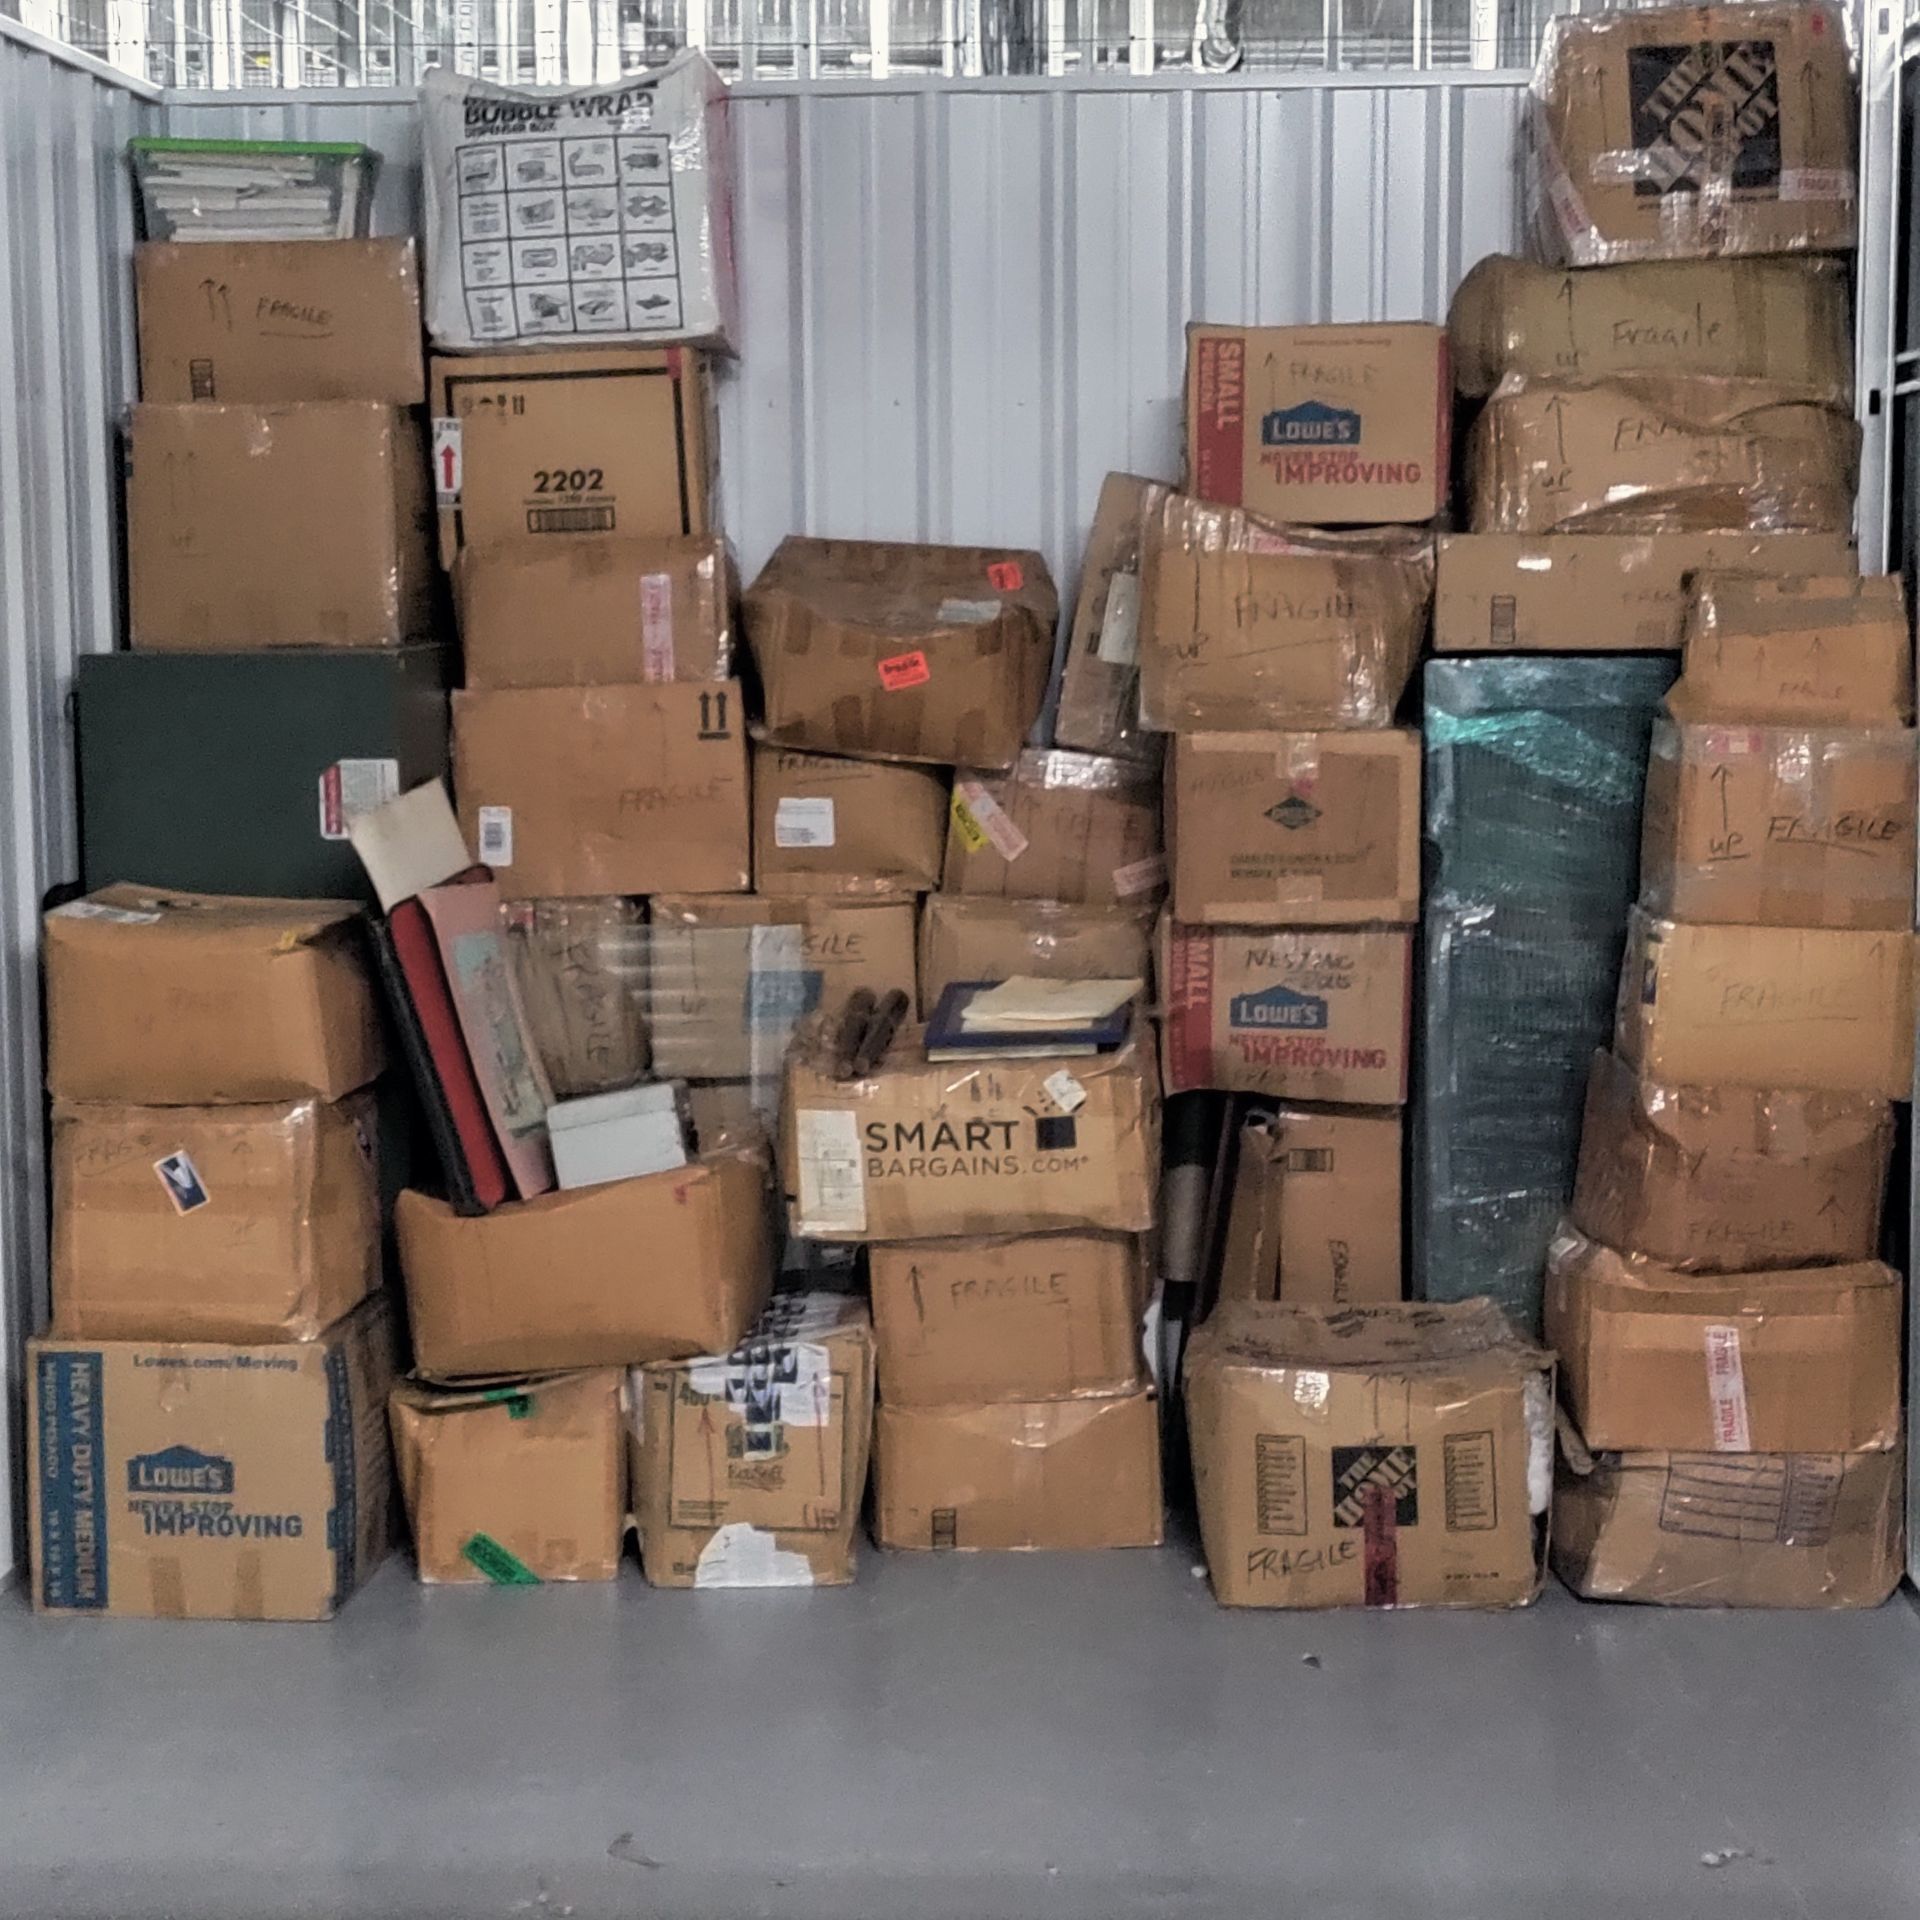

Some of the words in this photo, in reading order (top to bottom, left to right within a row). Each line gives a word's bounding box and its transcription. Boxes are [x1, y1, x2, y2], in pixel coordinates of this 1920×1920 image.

[1216, 343, 1241, 432] SMALL
[1272, 416, 1351, 440] LOWE'S
[534, 468, 604, 493] 2202
[1275, 462, 1422, 486] IMPROVING
[1188, 935, 1212, 1010] MALL
[1240, 1001, 1319, 1024] LOWE'S
[1243, 1047, 1387, 1069] IMPROVING
[866, 1120, 1020, 1152] SMART
[951, 1271, 1068, 1310] FRAGILE
[133, 1354, 298, 1372] Lowes.com/Moving
[1713, 1331, 1730, 1375] FRAGILE
[71, 1363, 93, 1441] HEAVY
[1719, 1399, 1738, 1443] FRAGILE
[72, 1444, 93, 1502] DUTY
[139, 1463, 225, 1488] LOWE'S
[1335, 1446, 1417, 1527] HOME
[1339, 1451, 1378, 1490] THE
[128, 1500, 184, 1514] NEVER
[194, 1501, 234, 1515] STOP
[144, 1511, 302, 1538] IMPROVING
[1247, 1541, 1358, 1584] FRAGILE
